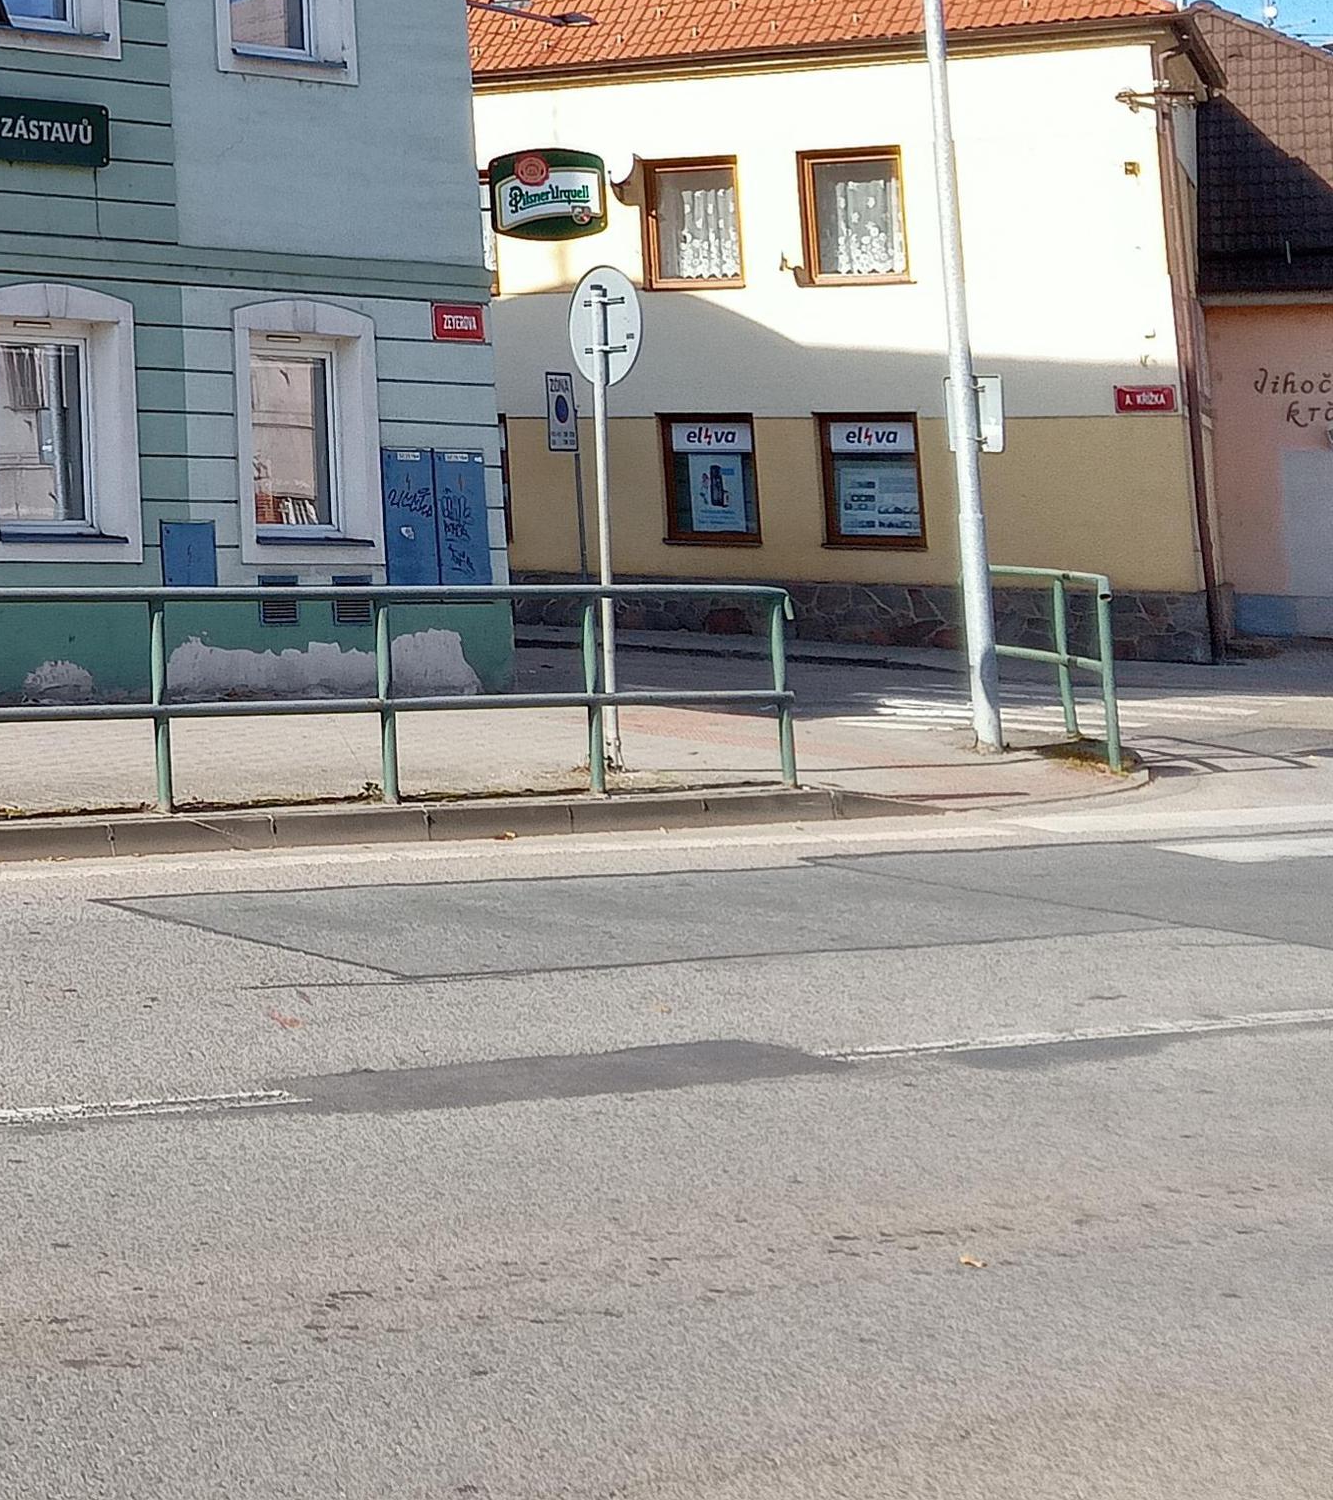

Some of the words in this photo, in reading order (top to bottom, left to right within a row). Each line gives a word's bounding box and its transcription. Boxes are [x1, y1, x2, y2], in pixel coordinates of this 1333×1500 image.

[0, 115, 93, 145] ZÁSTAVŮ
[508, 185, 550, 214] Pilsner
[548, 184, 590, 205] Urquell
